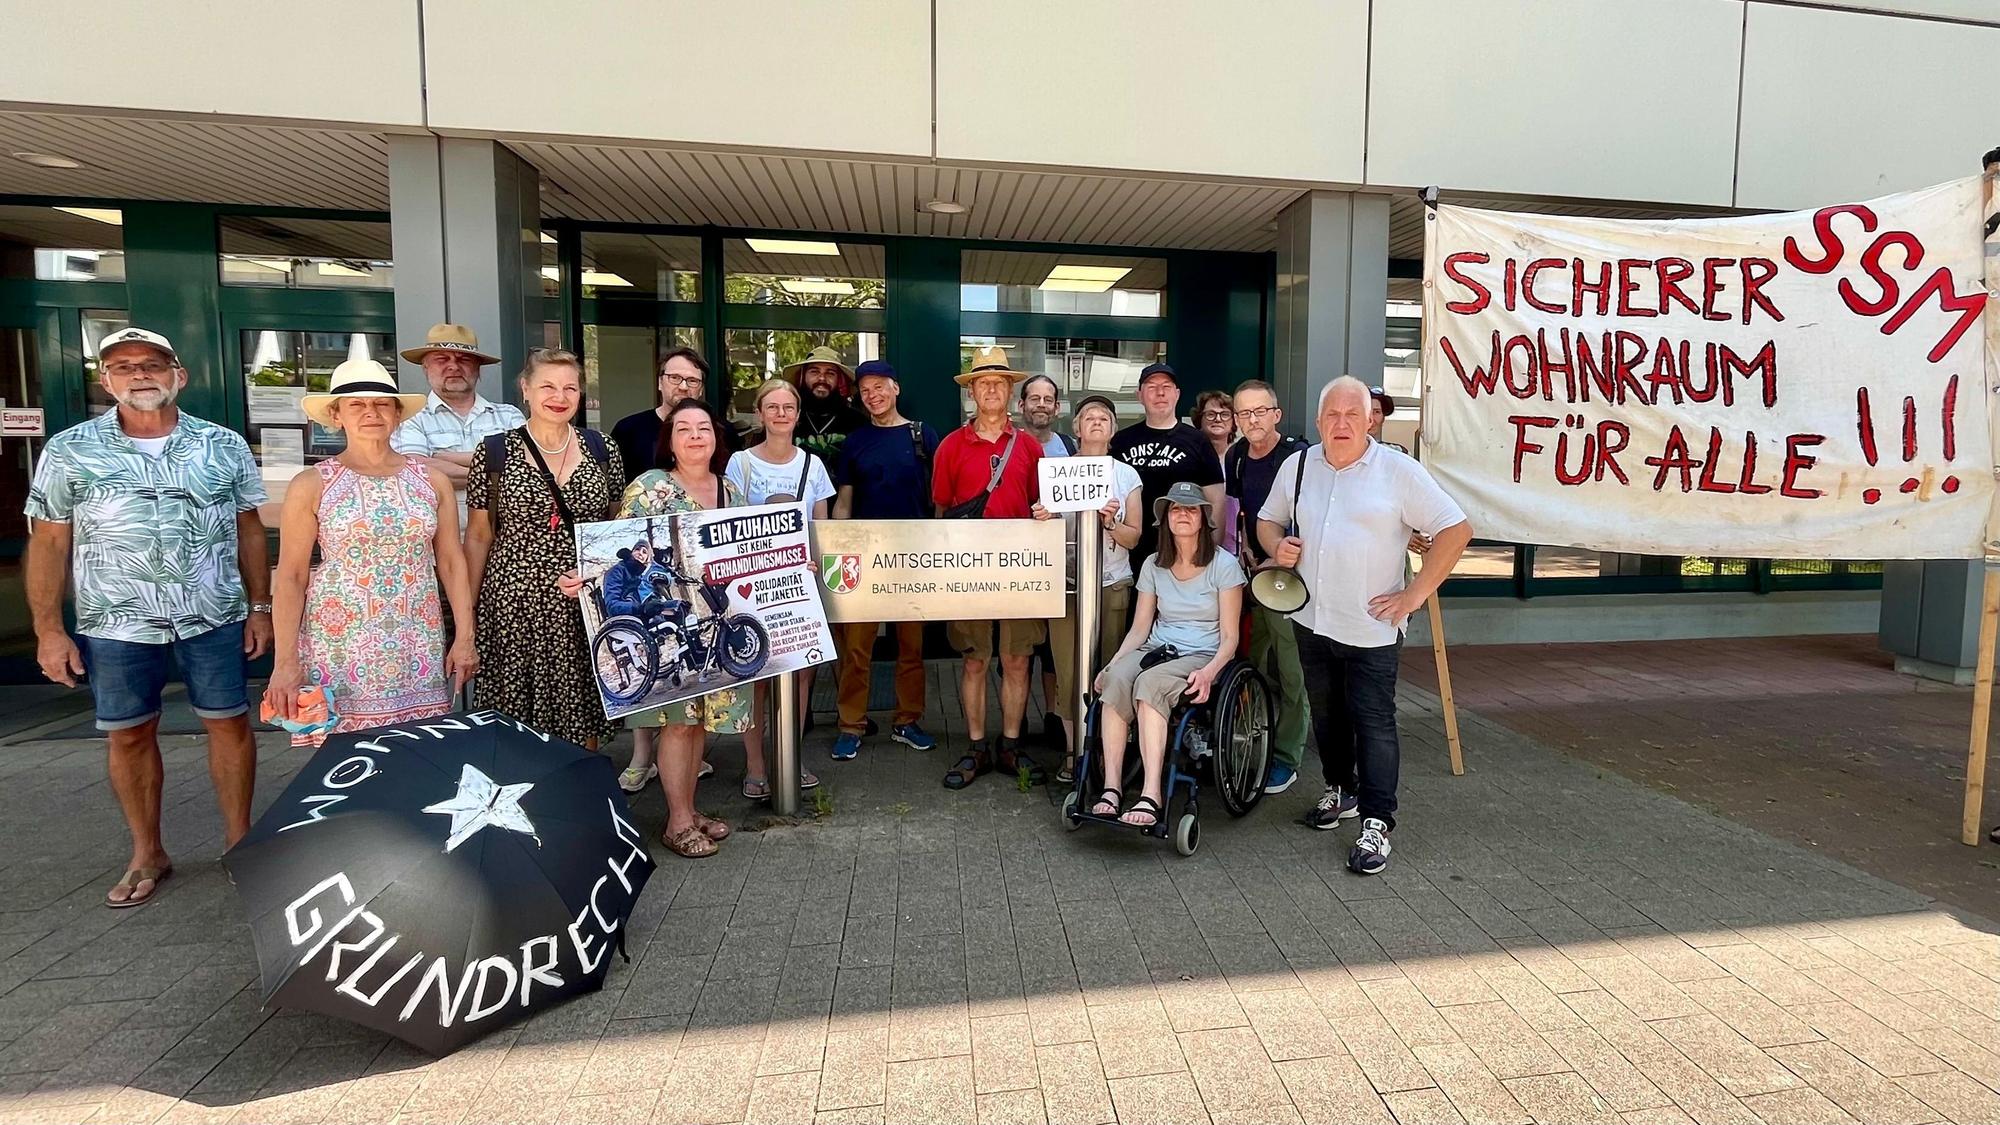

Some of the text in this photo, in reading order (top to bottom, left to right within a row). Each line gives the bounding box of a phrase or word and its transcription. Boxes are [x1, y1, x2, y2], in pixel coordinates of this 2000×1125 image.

[1444, 251, 1785, 325] SICHERER
[1783, 204, 1988, 363] SSM
[1439, 327, 1777, 408] WOHNRAUM
[3, 413, 40, 424] Eingang
[1508, 414, 1630, 486] FÜR
[1645, 425, 1827, 499] ALLE
[1048, 464, 1104, 478] JANETTE
[1052, 484, 1109, 502] BLEIBT!
[709, 512, 797, 545] EIN ZUHAUSE
[737, 538, 773, 555] IST KEINE
[709, 547, 805, 581] VERHANDLUNGSMASSE.
[872, 549, 1053, 569] AMTSGERICHT BRÜHL
[754, 571, 803, 592] SOLIDARITÄT
[872, 583, 937, 594] BALTHASAR
[946, 581, 1001, 593] NEUMANN
[1009, 580, 1042, 592] PLATZ
[1044, 580, 1051, 592] 3
[755, 586, 809, 605] MIT JANETTE.
[789, 616, 806, 625] STARK
[284, 797, 647, 1028] GRUNDRECHT
